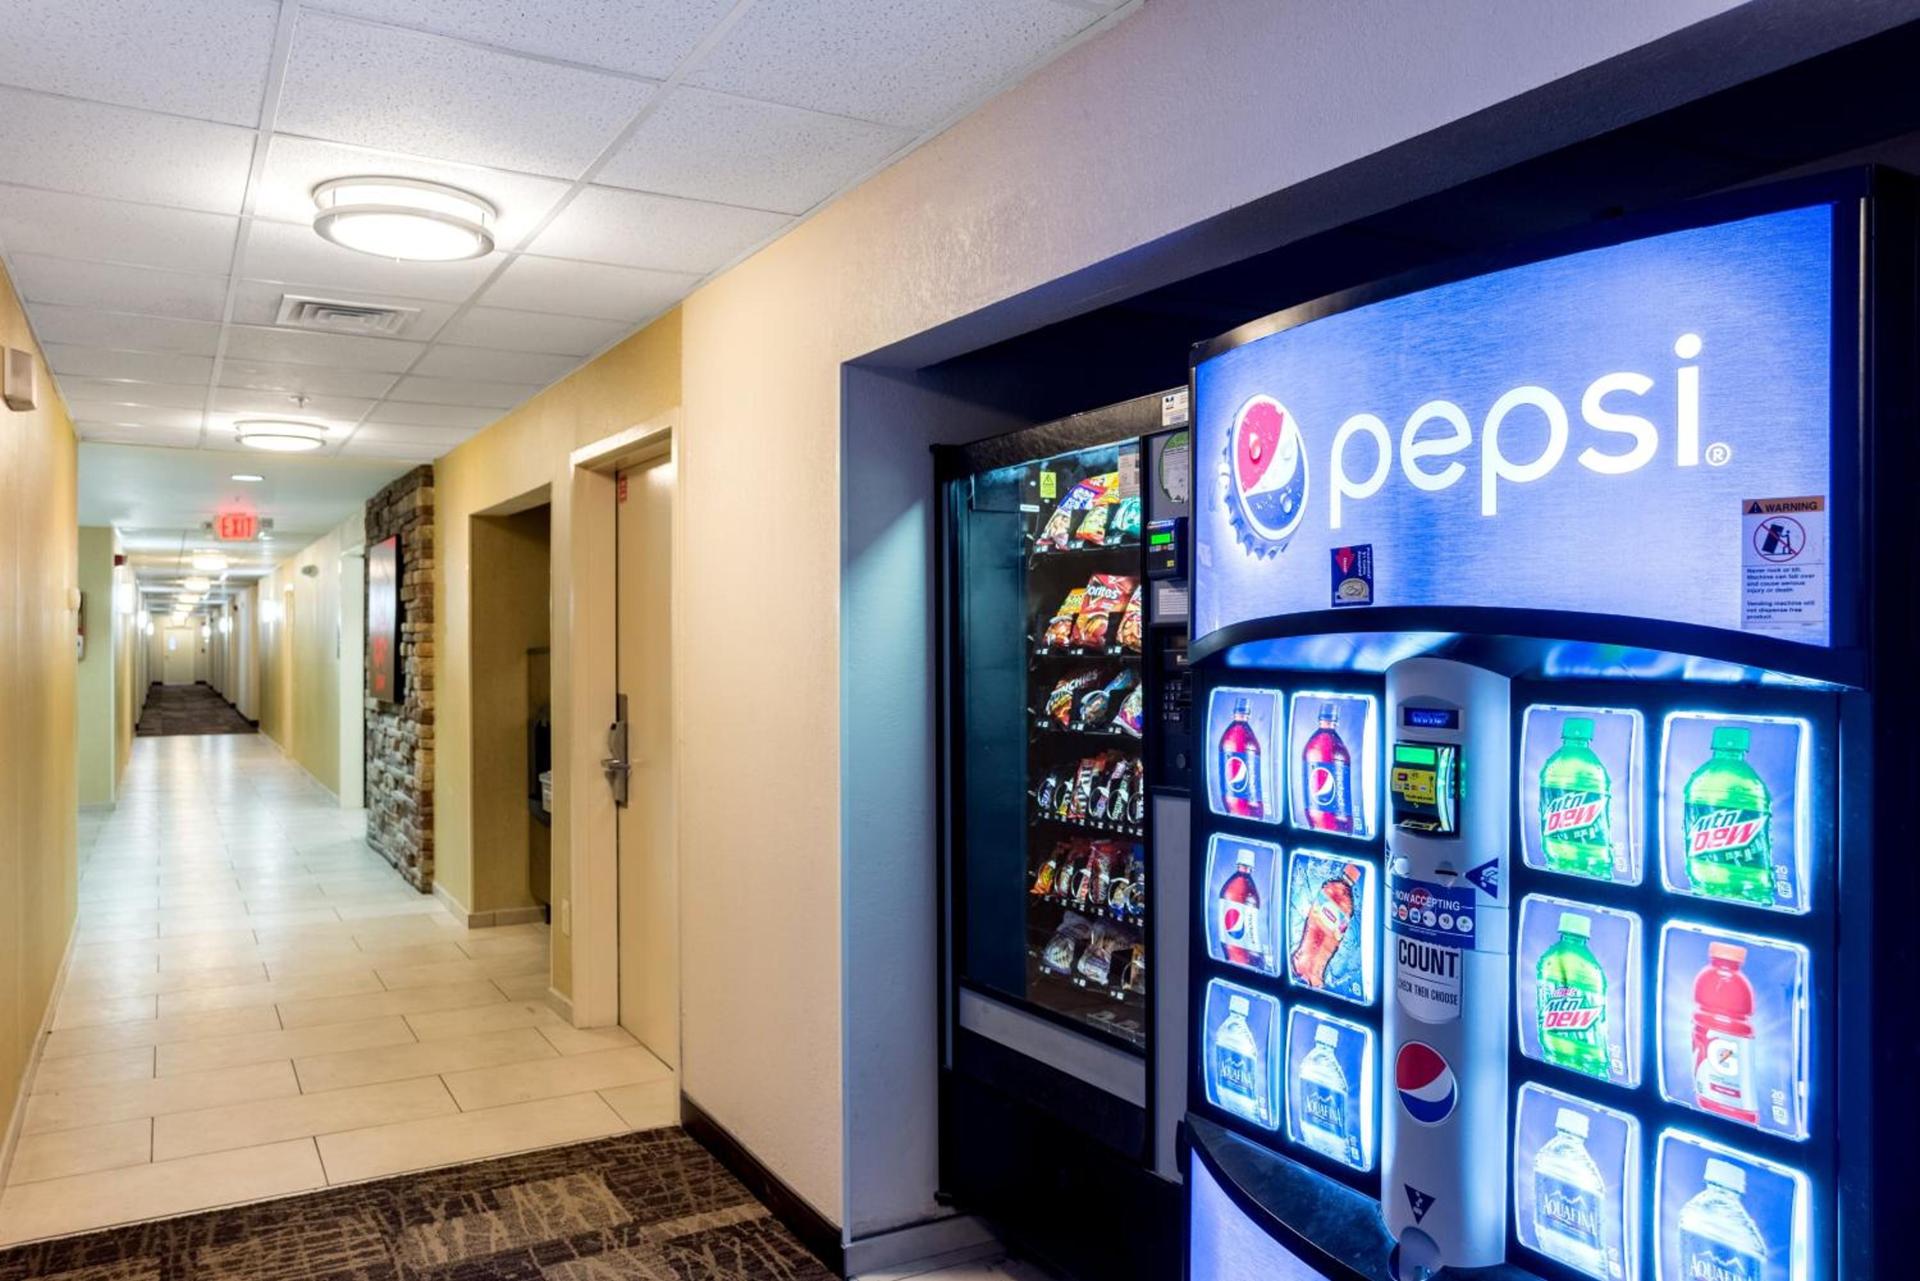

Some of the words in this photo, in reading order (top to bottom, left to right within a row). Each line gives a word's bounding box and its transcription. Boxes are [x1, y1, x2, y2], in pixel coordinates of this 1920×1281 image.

[1329, 332, 1703, 529] pepsi
[1765, 501, 1818, 512] WARNING
[221, 517, 252, 538] EXIT
[1410, 894, 1461, 911] ACCEPTING
[1415, 984, 1429, 999] THEN
[1431, 989, 1458, 1006] CHOOSE
[1543, 1193, 1597, 1236] AQUAFINA
